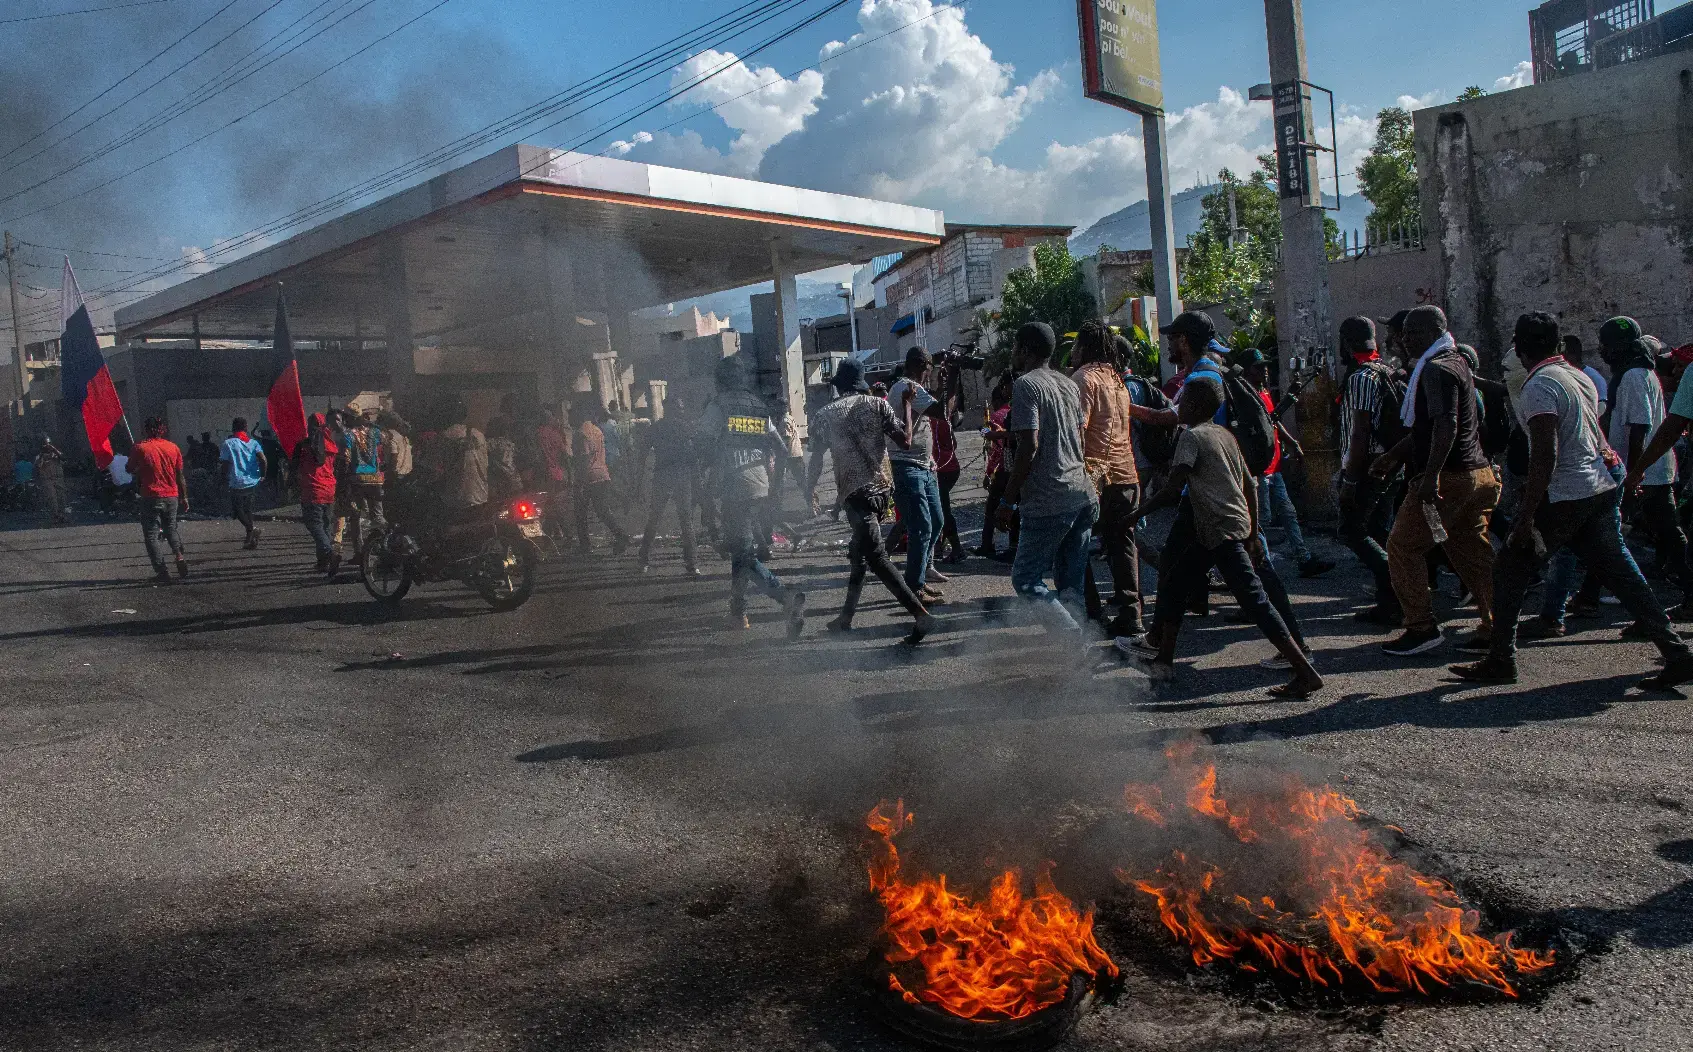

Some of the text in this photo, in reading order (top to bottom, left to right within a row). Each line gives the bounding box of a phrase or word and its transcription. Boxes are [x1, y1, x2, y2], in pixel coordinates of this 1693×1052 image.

[1100, 18, 1118, 35] pou
[1101, 40, 1112, 54] pi
[728, 416, 766, 434] PRESSE
